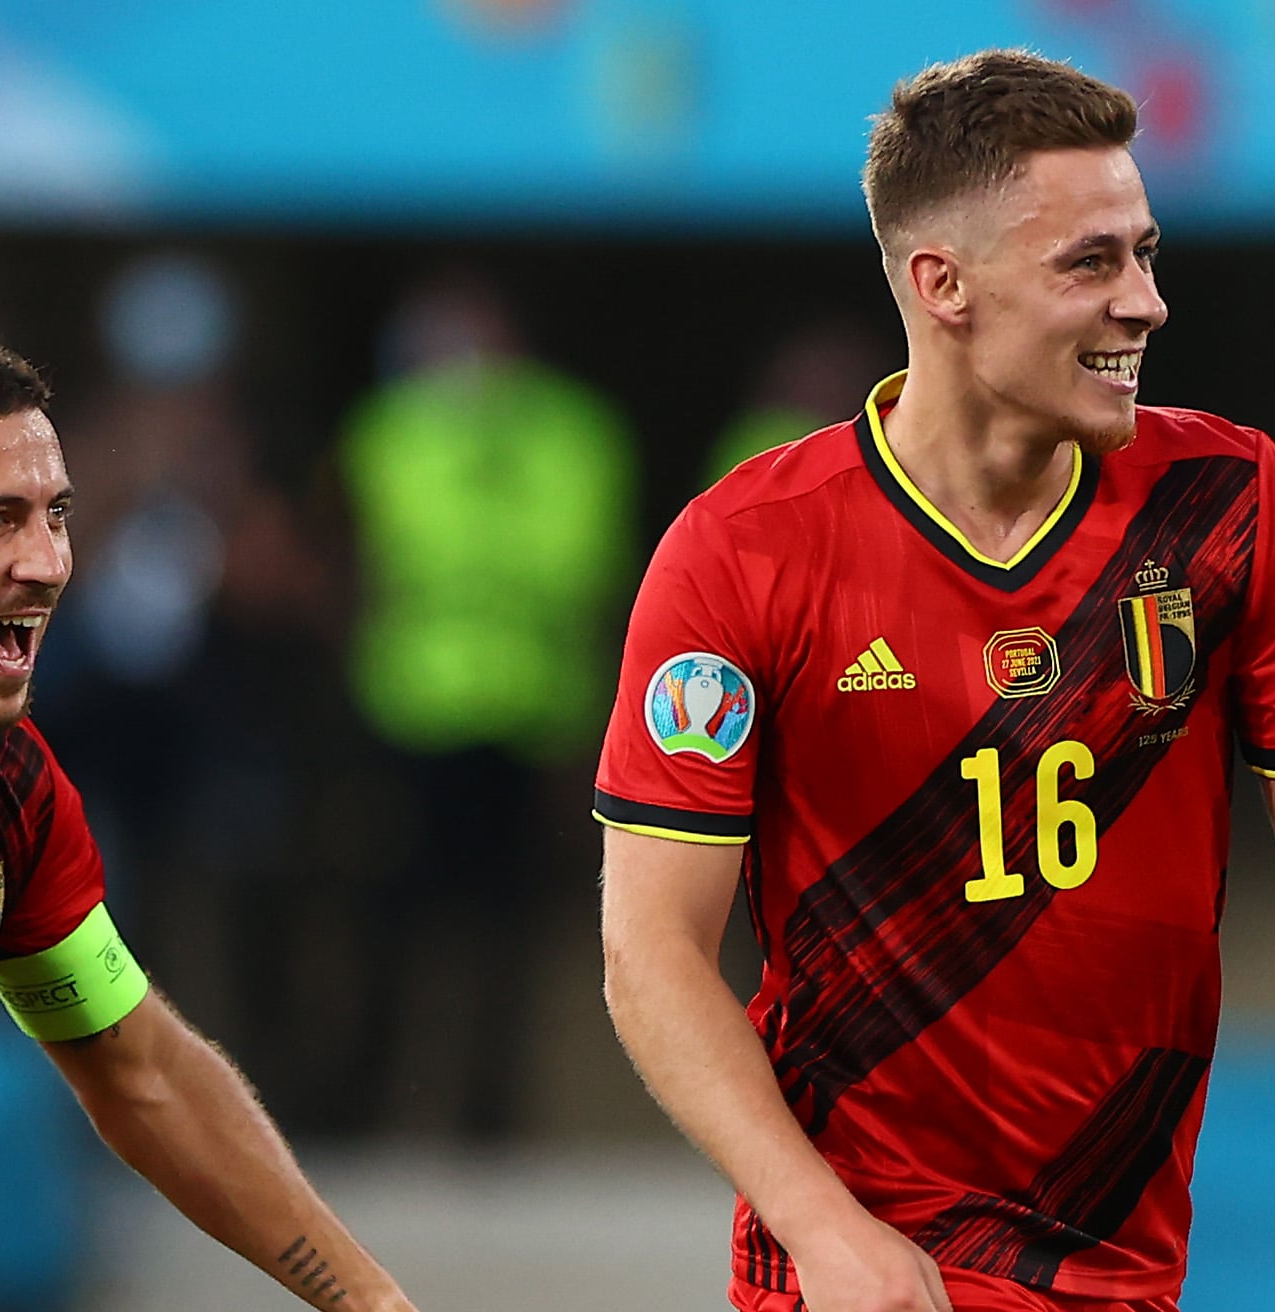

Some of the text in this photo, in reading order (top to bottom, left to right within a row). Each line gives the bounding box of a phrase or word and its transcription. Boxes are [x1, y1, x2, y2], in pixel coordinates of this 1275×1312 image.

[837, 671, 916, 692] adidas
[1009, 666, 1036, 678] SEVILLA
[959, 740, 1099, 904] 16
